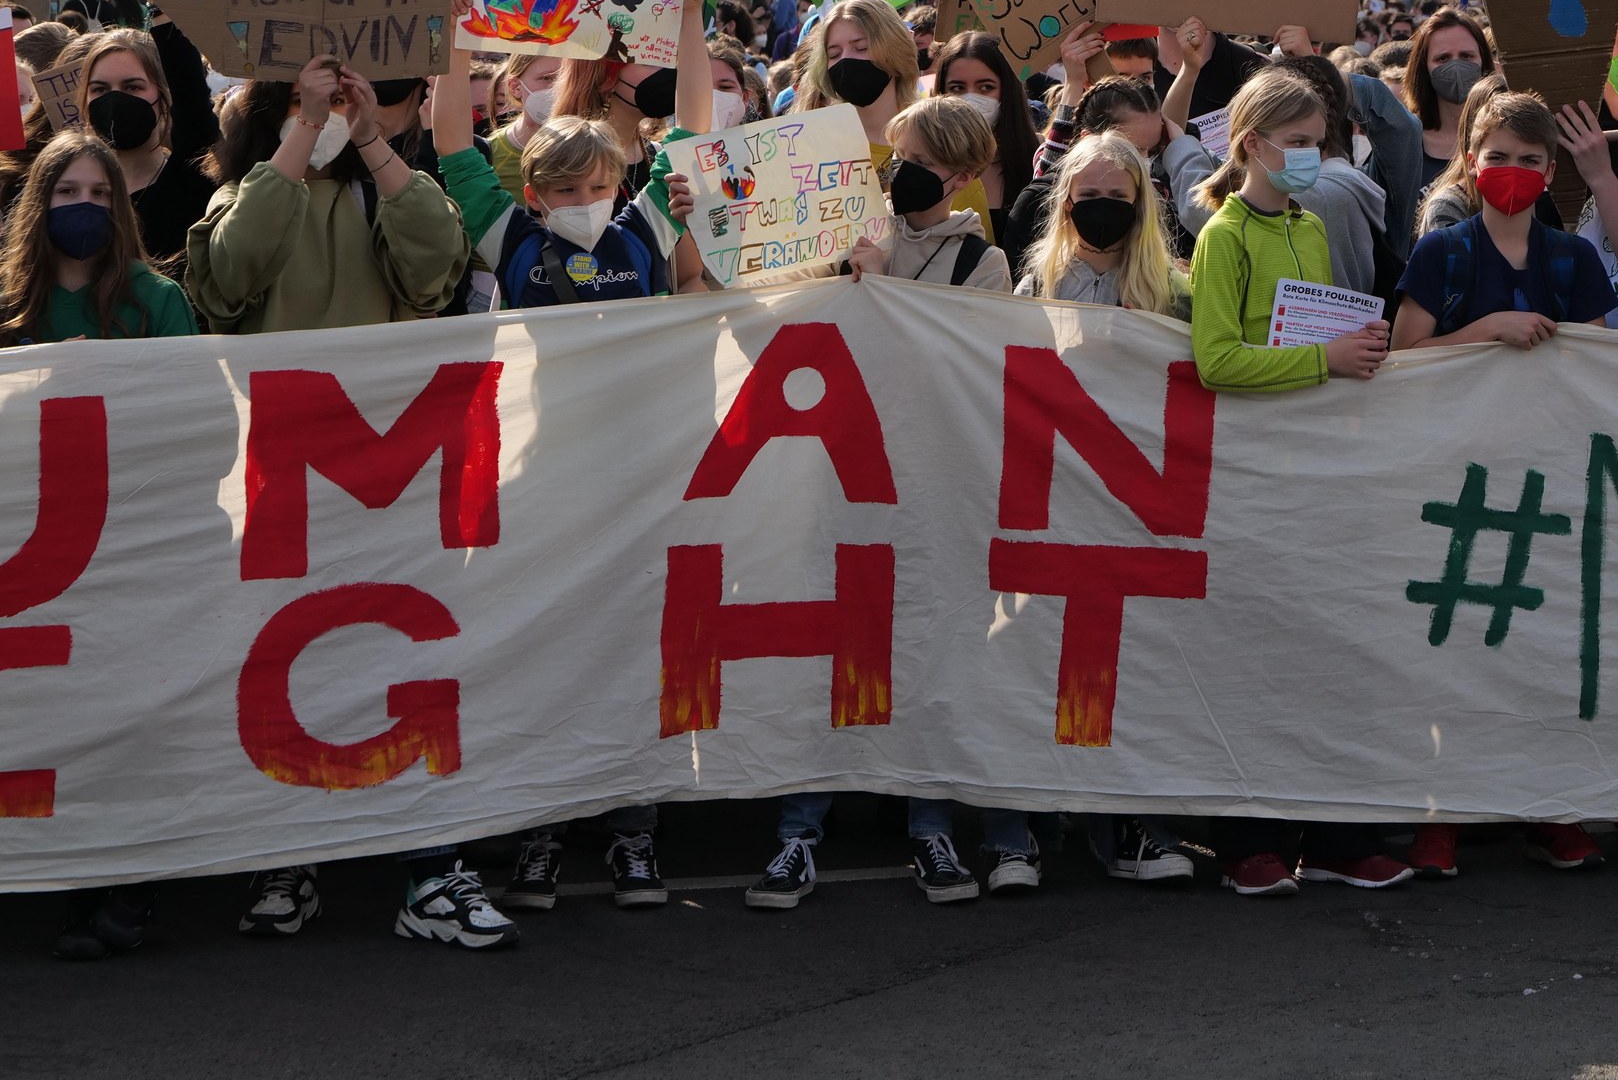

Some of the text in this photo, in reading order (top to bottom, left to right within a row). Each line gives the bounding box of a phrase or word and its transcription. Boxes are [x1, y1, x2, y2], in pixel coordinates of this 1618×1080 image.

[56, 98, 79, 120] IS
[695, 123, 804, 173] ES IST
[790, 159, 873, 194] ZEIT
[708, 192, 866, 238] ETWAS ZU
[1284, 284, 1378, 309] GROBES FOULSPIEL!
